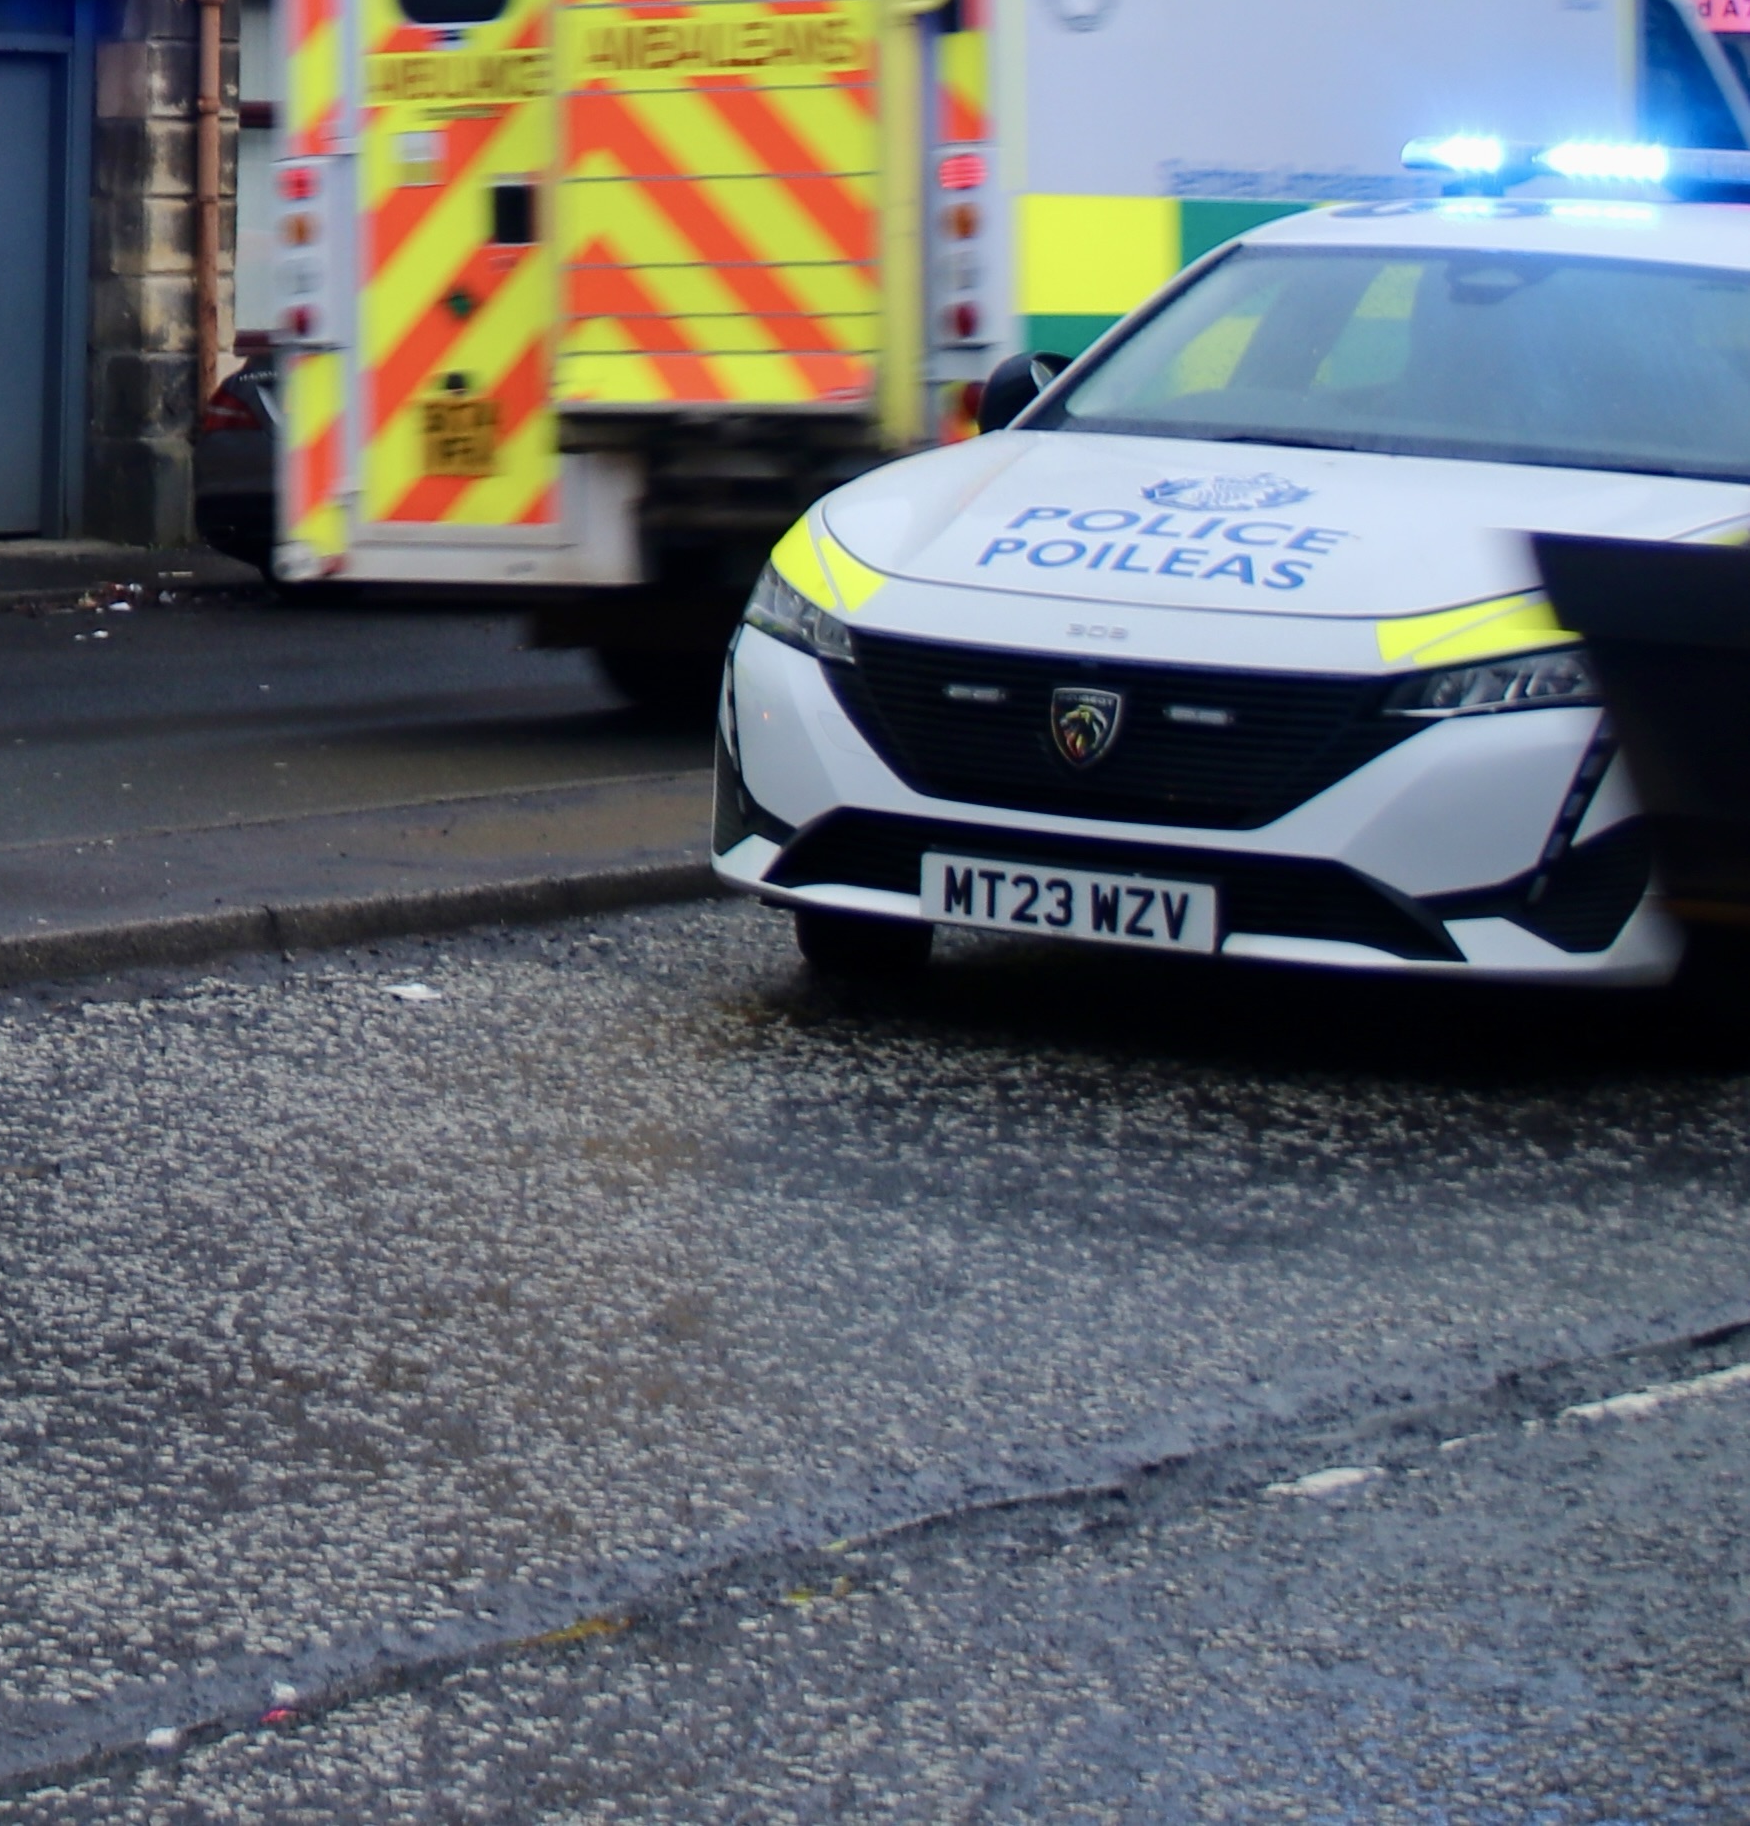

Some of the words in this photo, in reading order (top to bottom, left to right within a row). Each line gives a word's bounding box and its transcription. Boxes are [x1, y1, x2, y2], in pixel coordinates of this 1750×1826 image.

[1005, 505, 1350, 555] POLICE
[975, 537, 1315, 590] POILEAS
[943, 864, 1074, 927] MT23
[1090, 881, 1190, 942] WZV
